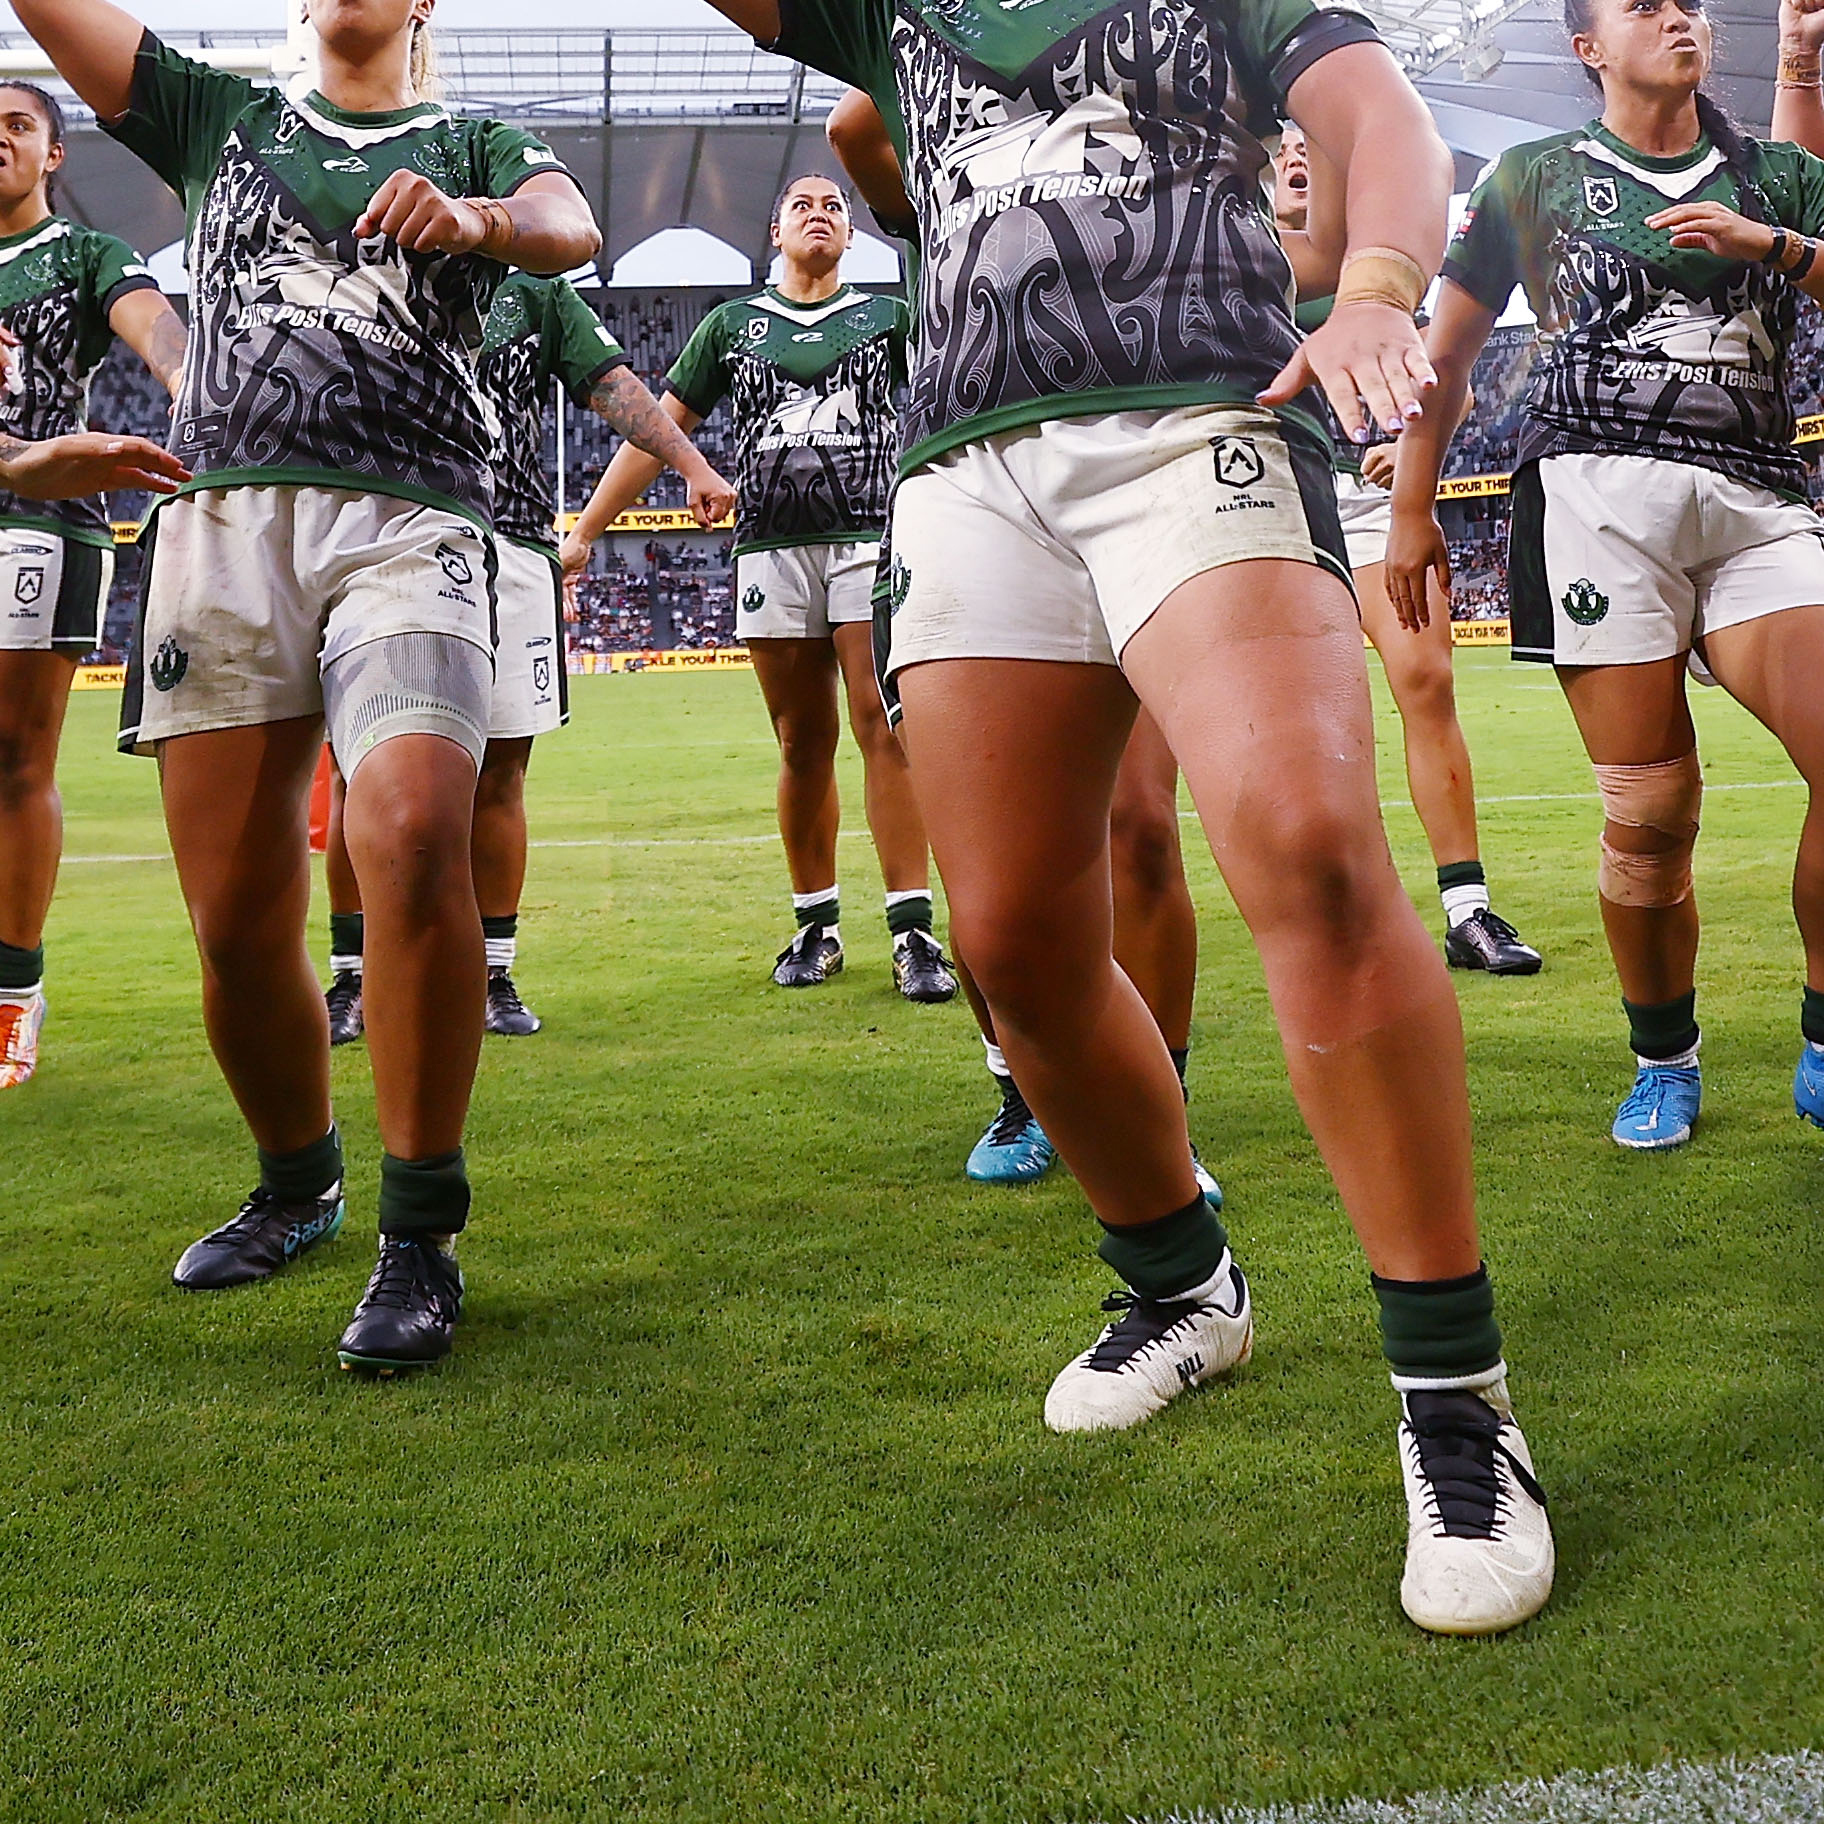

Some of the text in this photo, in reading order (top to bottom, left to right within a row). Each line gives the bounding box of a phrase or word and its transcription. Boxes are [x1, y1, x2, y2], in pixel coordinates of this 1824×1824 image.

[971, 176, 1028, 223] Post
[1027, 174, 1151, 209] Tension
[236, 303, 277, 330] Ellis
[277, 304, 329, 329] Post
[1614, 360, 1775, 393] Ellis Post Tension
[1797, 419, 1824, 437] HIRST
[778, 429, 810, 448] Post
[811, 430, 861, 447] Tension
[1451, 480, 1482, 493] YOUR
[1233, 493, 1253, 501] NRL
[1215, 500, 1276, 515] ALL-STARS
[634, 513, 674, 526] YOUR
[84, 673, 124, 684] TACKL
